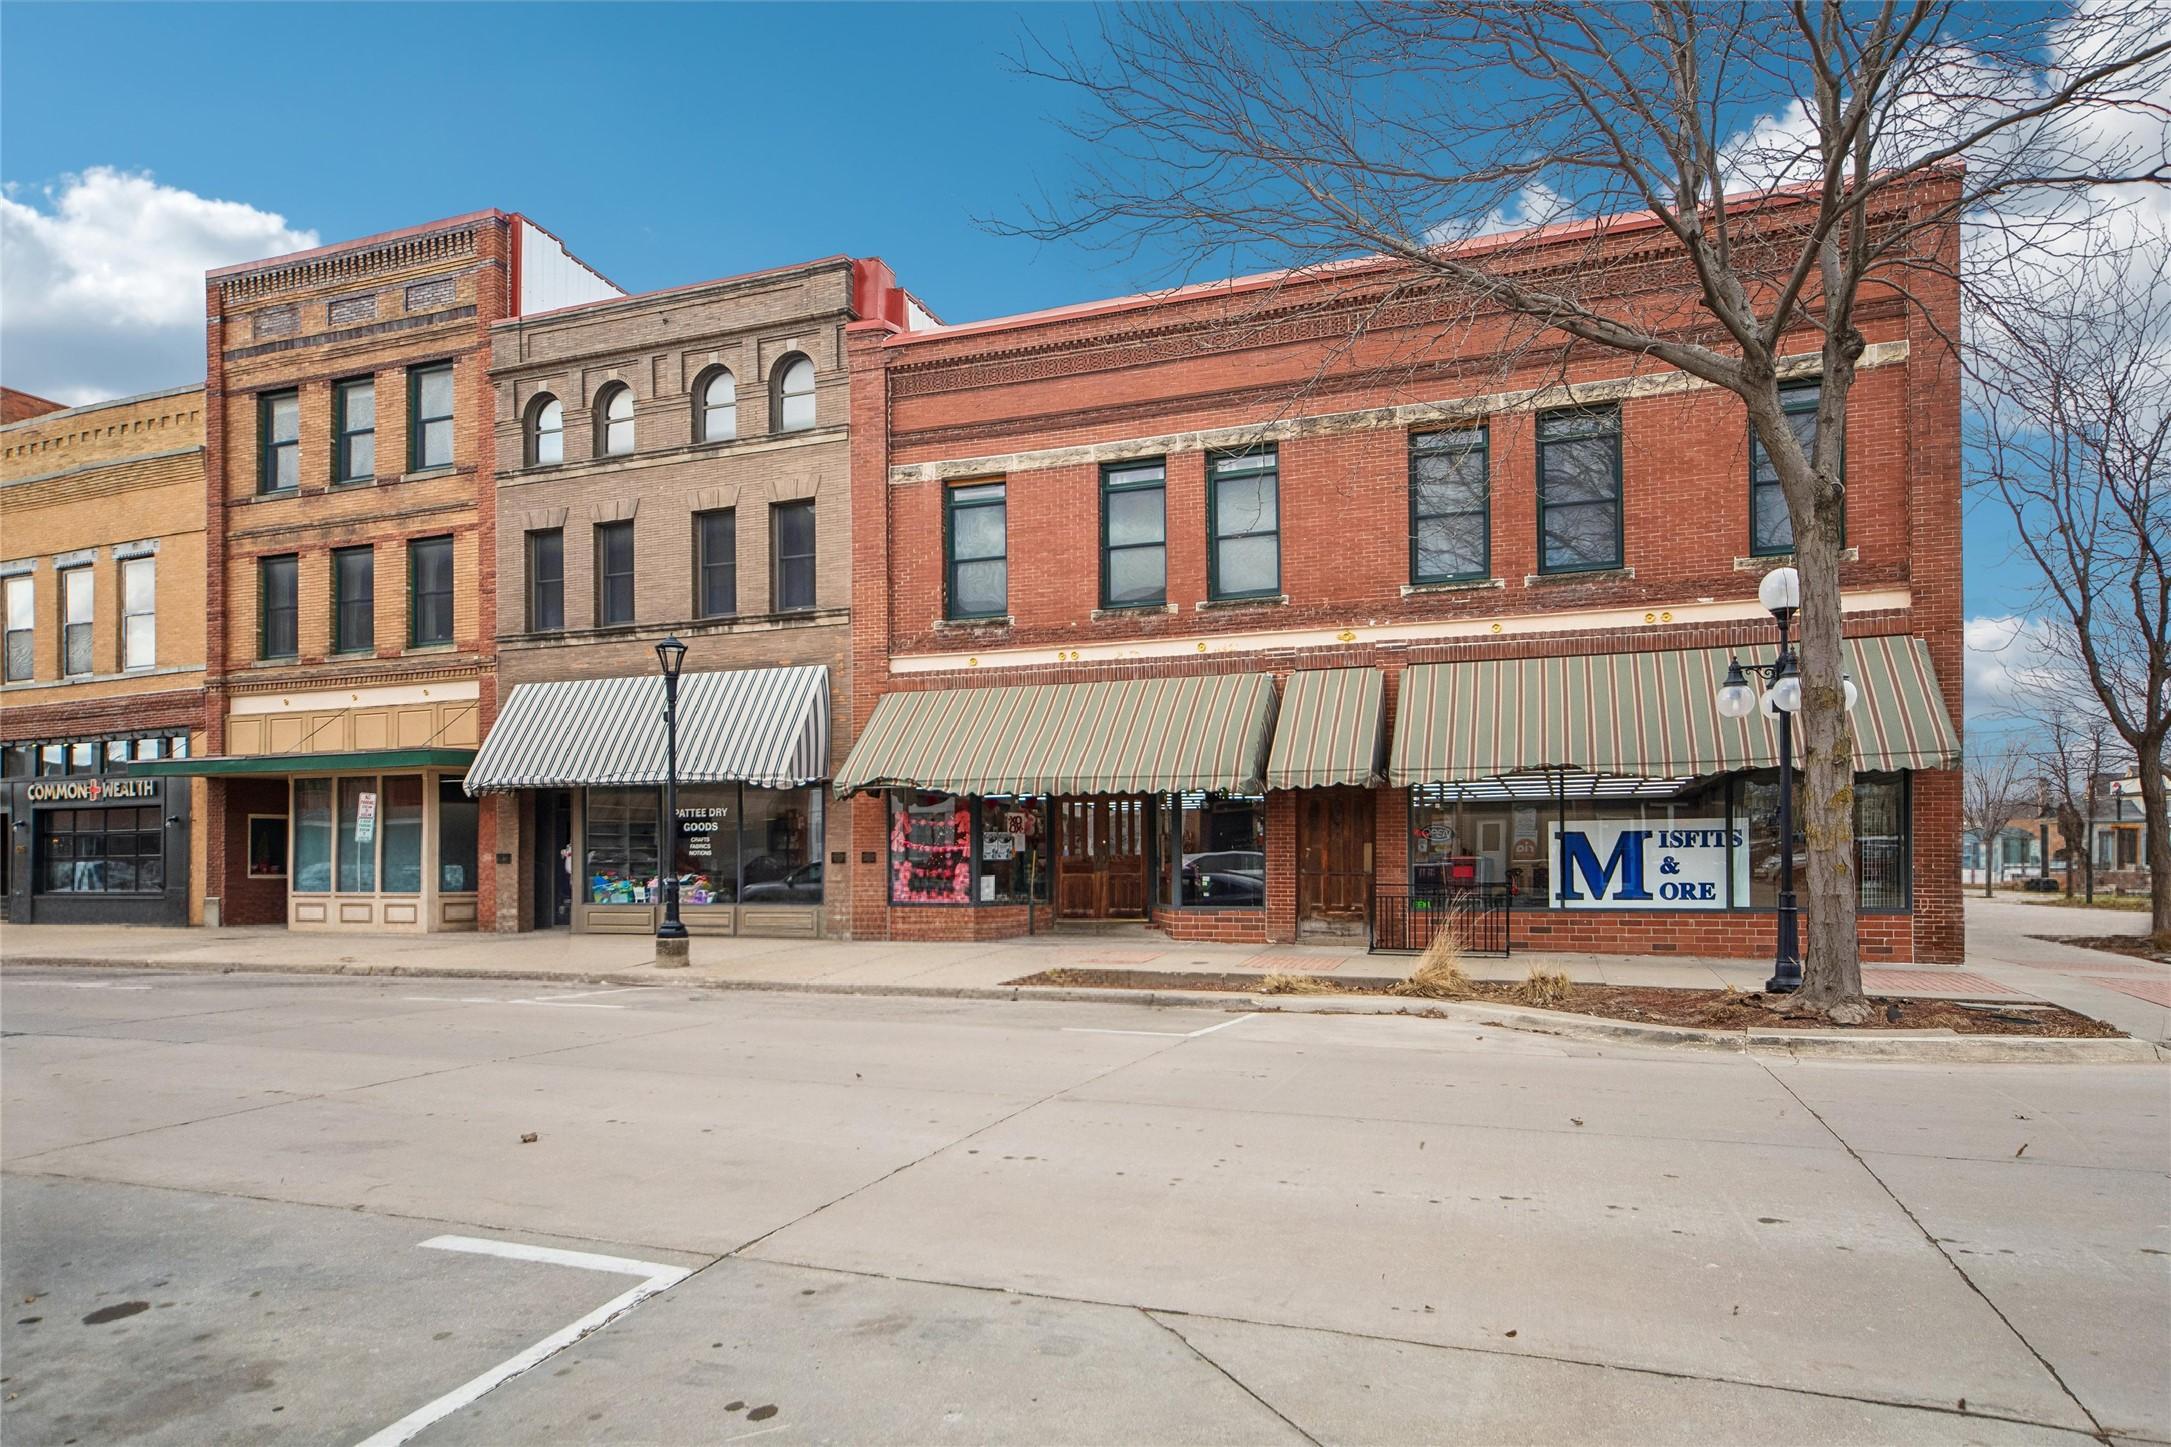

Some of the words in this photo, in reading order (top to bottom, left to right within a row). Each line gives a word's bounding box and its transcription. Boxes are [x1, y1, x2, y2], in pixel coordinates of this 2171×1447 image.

[27, 782, 87, 800] COMMON
[102, 780, 154, 798] WEALTH
[708, 807, 728, 817] DRY
[683, 822, 719, 832] GOODS
[1659, 856, 1681, 875] &
